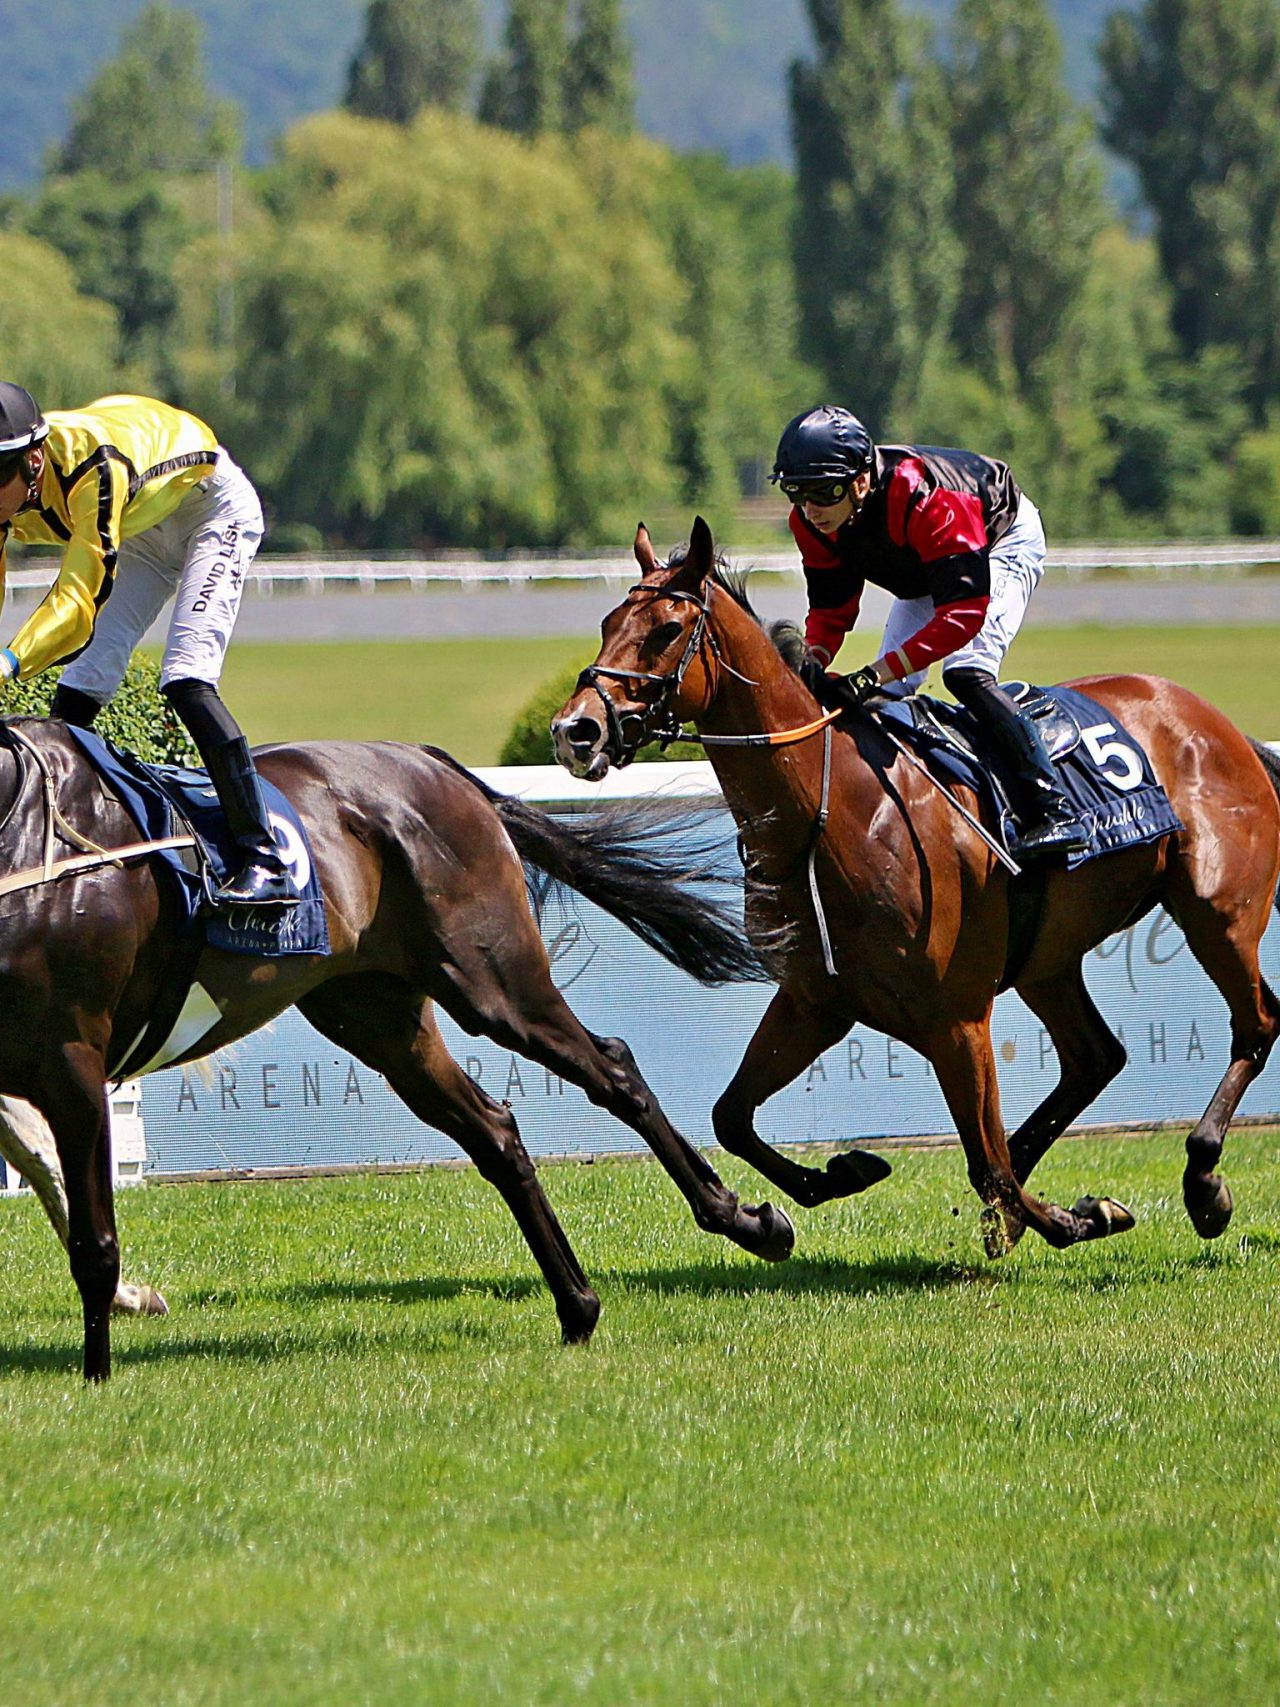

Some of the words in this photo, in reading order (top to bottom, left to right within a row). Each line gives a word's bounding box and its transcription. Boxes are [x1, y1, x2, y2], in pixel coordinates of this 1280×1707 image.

[192, 562, 226, 612] DAVID
[1082, 722, 1143, 791] 5
[268, 813, 310, 891] 9
[177, 1060, 365, 1112] ARENA
